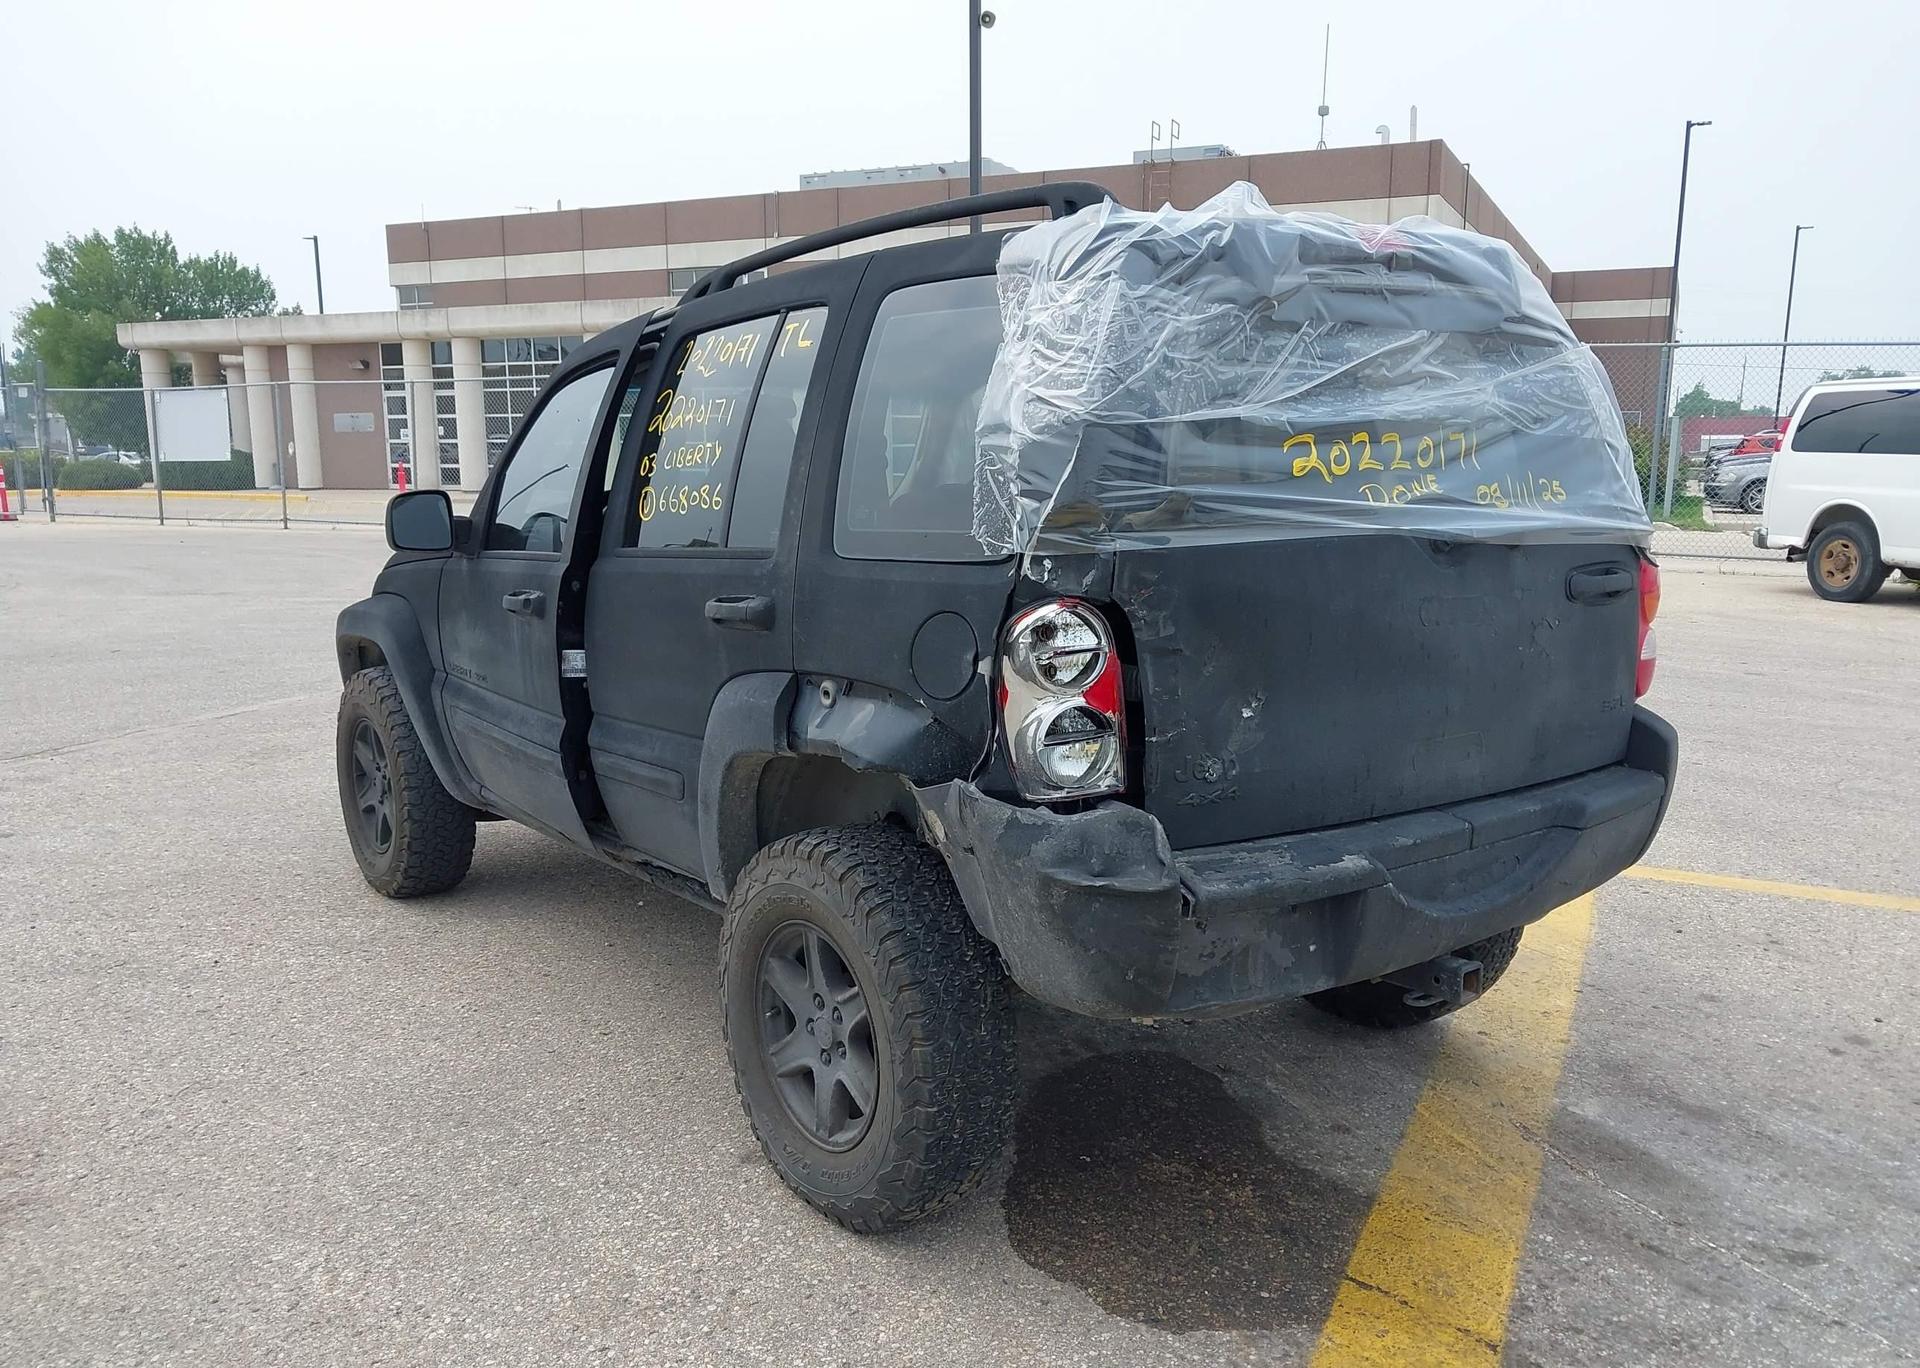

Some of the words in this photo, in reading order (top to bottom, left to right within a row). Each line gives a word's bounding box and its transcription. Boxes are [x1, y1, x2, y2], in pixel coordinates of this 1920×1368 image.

[676, 334, 761, 377] 20220171
[648, 388, 736, 436] 20220171
[664, 440, 722, 469] LIBERTY
[1283, 424, 1481, 483] 20220171
[660, 483, 723, 515] 668086
[1359, 474, 1444, 505] DONE
